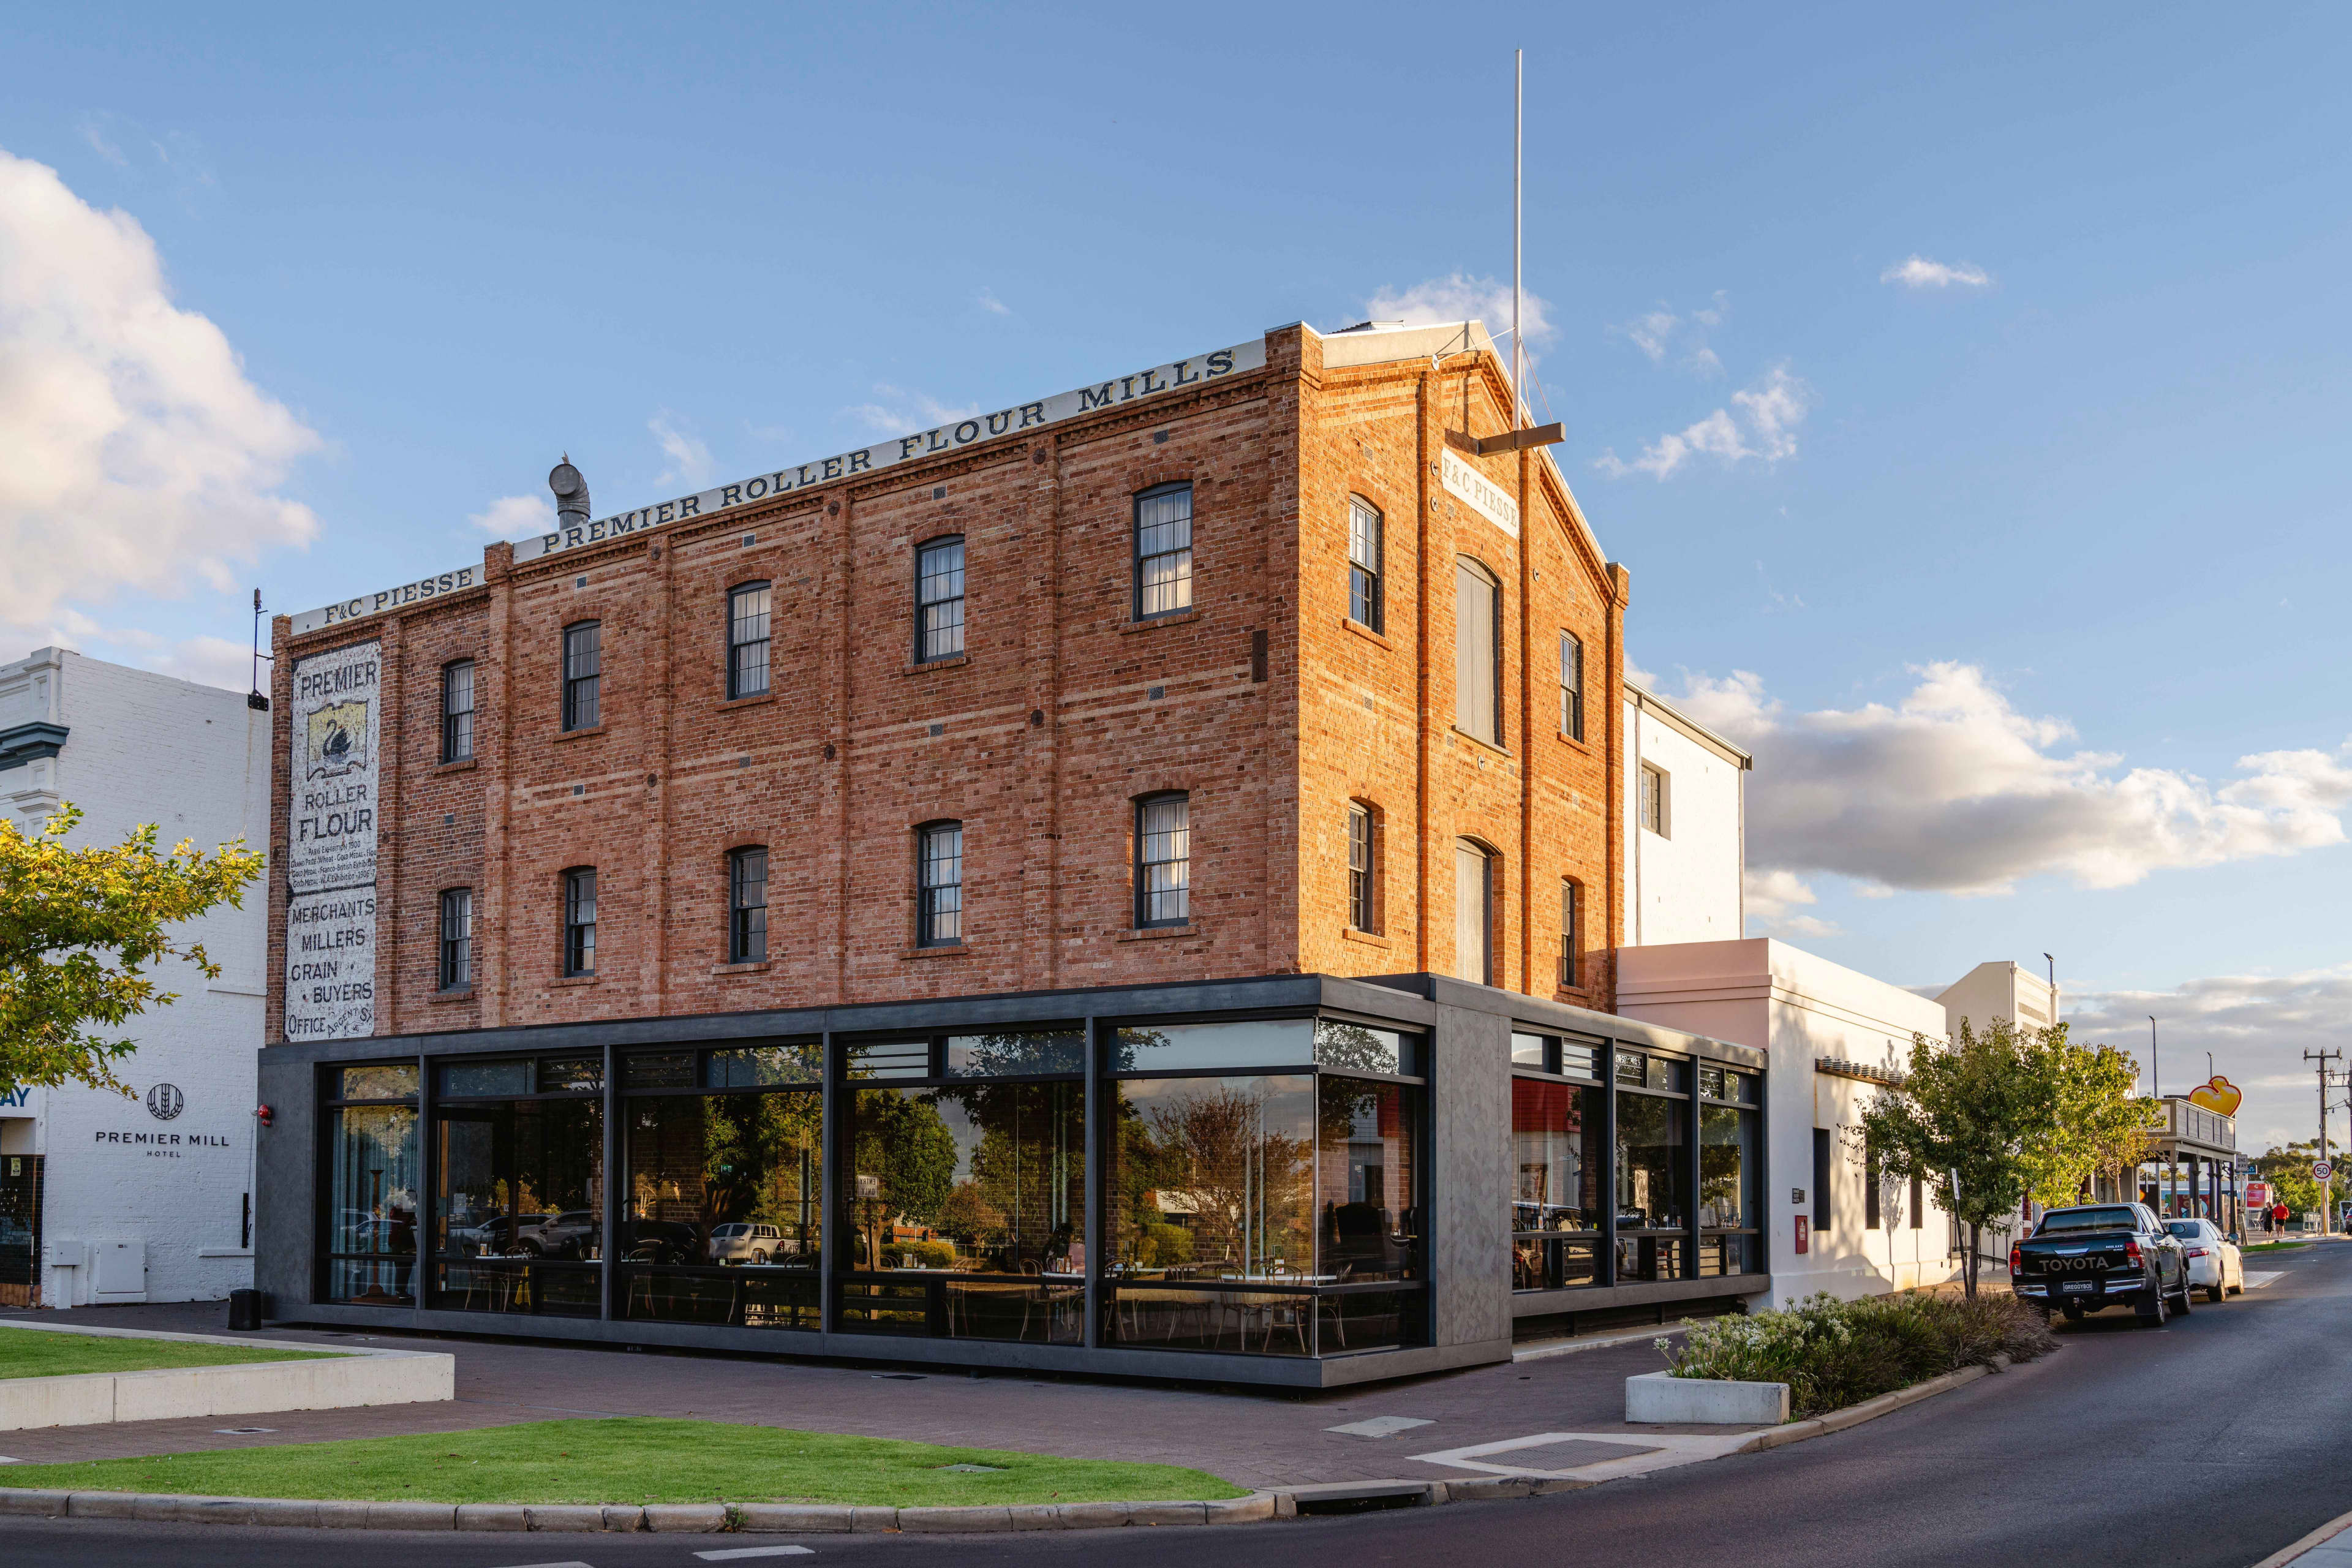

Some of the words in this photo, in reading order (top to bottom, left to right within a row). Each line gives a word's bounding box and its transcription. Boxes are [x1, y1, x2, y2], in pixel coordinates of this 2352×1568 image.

[543, 495, 701, 554] PREMIER
[721, 449, 872, 508] ROLLER
[899, 401, 1046, 461] FLOUR
[1077, 350, 1236, 413] MILLS
[1474, 479, 1517, 527] PIESSE
[374, 568, 473, 611] PIESSE
[301, 661, 377, 699] PREMIER
[305, 784, 368, 811] ROLLER
[299, 809, 372, 842] FLOUR
[349, 840, 361, 850] 1900
[292, 899, 375, 924] MERCHANTS
[302, 929, 366, 952] MILLERS
[291, 961, 338, 981] GRAIN
[313, 982, 372, 1003] BUYERS
[288, 1014, 326, 1035] OFFICE
[328, 1009, 358, 1038] ARGENT
[96, 1131, 181, 1145] PREMIER
[189, 1135, 229, 1146] MILL
[2039, 1256, 2109, 1272] TOYOTA
